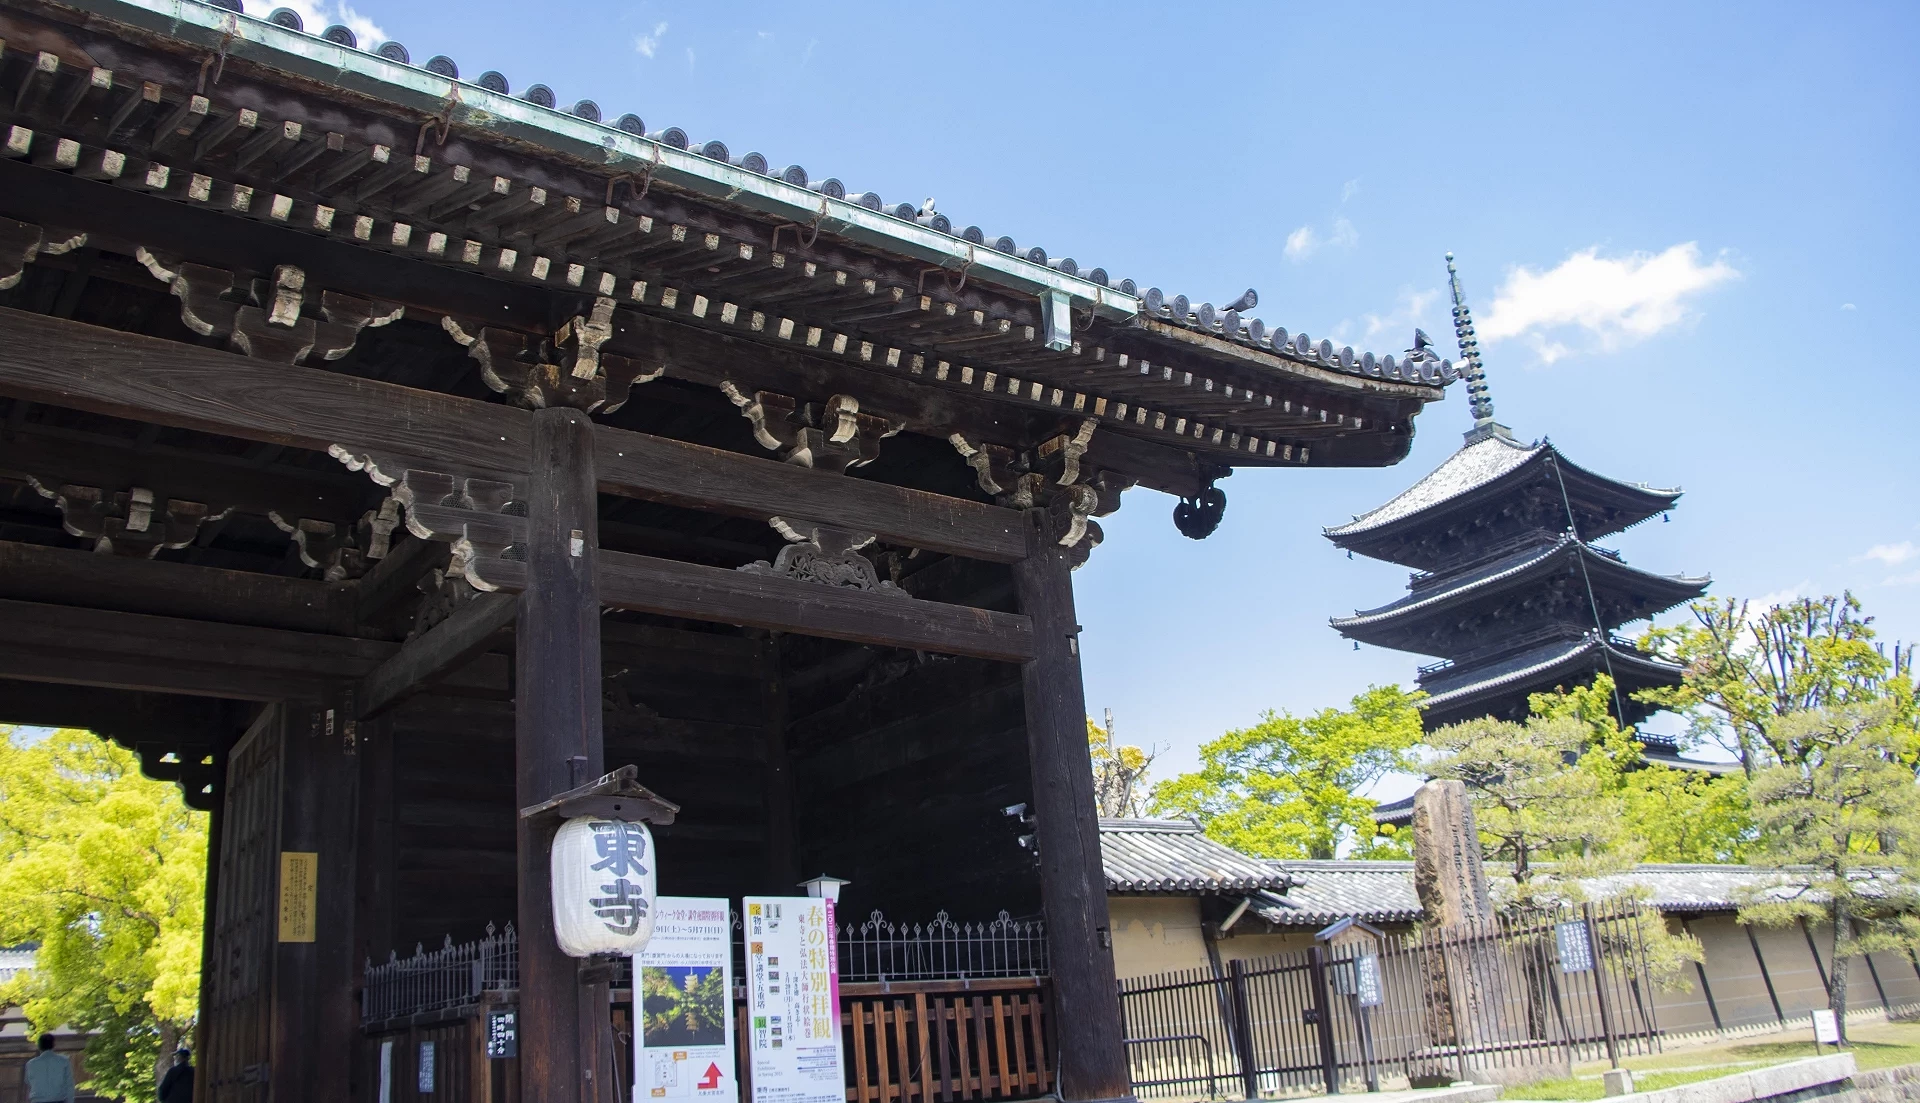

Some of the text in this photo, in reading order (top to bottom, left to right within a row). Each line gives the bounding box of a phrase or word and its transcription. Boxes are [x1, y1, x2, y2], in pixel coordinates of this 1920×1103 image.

[588, 822, 649, 936] 東寺
[752, 905, 762, 935] 宝物館
[754, 944, 766, 1009] 金堂・講堂・五重塔
[798, 914, 811, 1039] 東寺と弘法大師行状絵巻
[808, 905, 831, 1039] 春の特別拝観
[496, 1016, 506, 1055] 四時四十分
[505, 1013, 515, 1041] 閉門
[758, 1018, 768, 1049] 観智院
